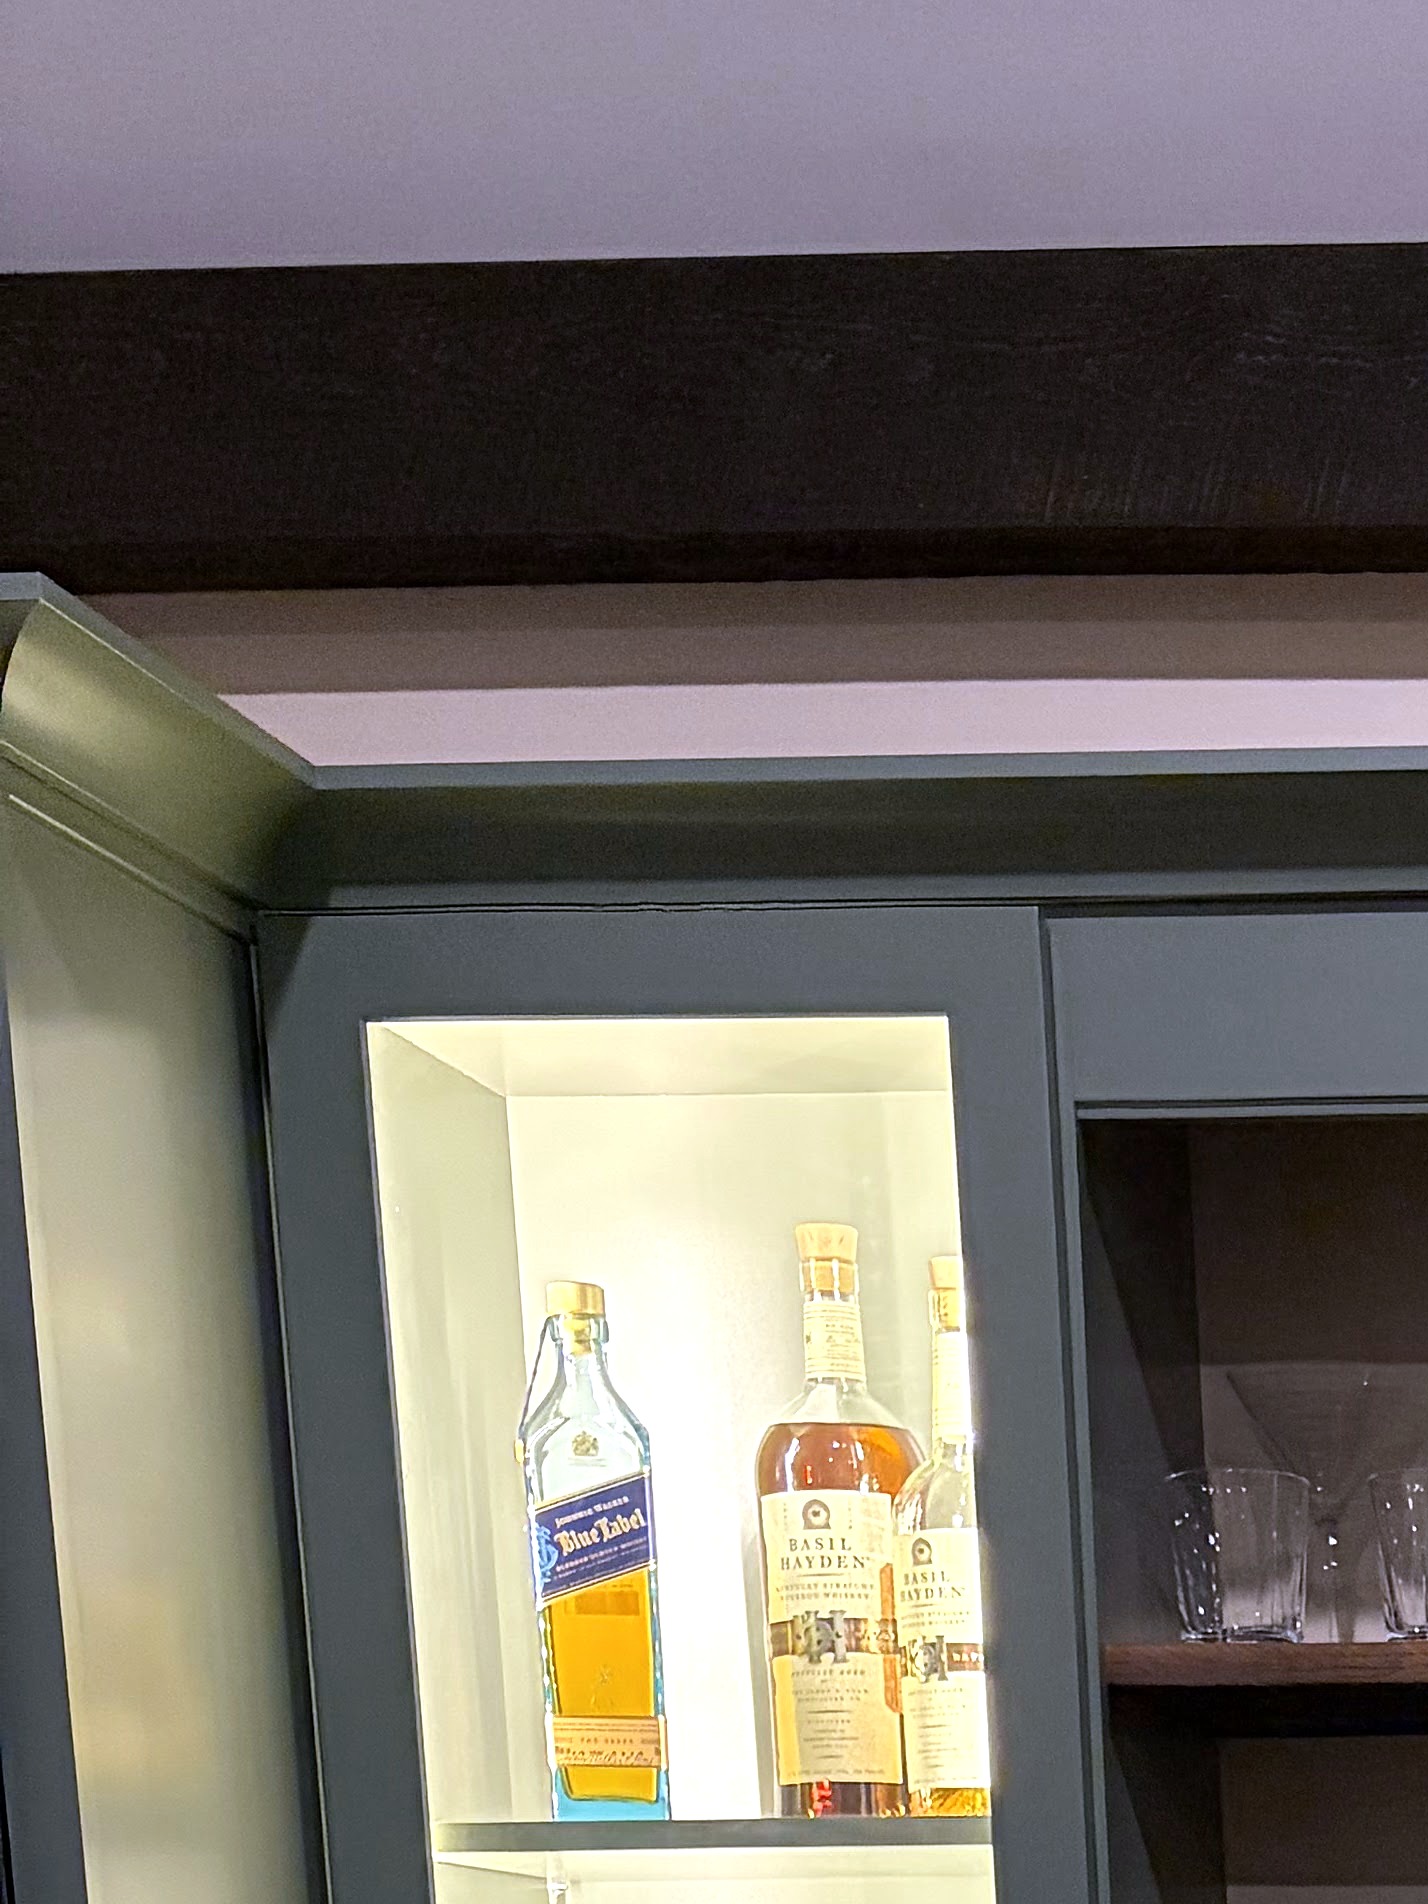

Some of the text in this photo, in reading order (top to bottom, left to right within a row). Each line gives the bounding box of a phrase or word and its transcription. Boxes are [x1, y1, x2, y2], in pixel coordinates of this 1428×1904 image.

[553, 1508, 647, 1557] Blue Label
[788, 1537, 852, 1552] BASIL
[780, 1554, 866, 1570] HAYDEN
